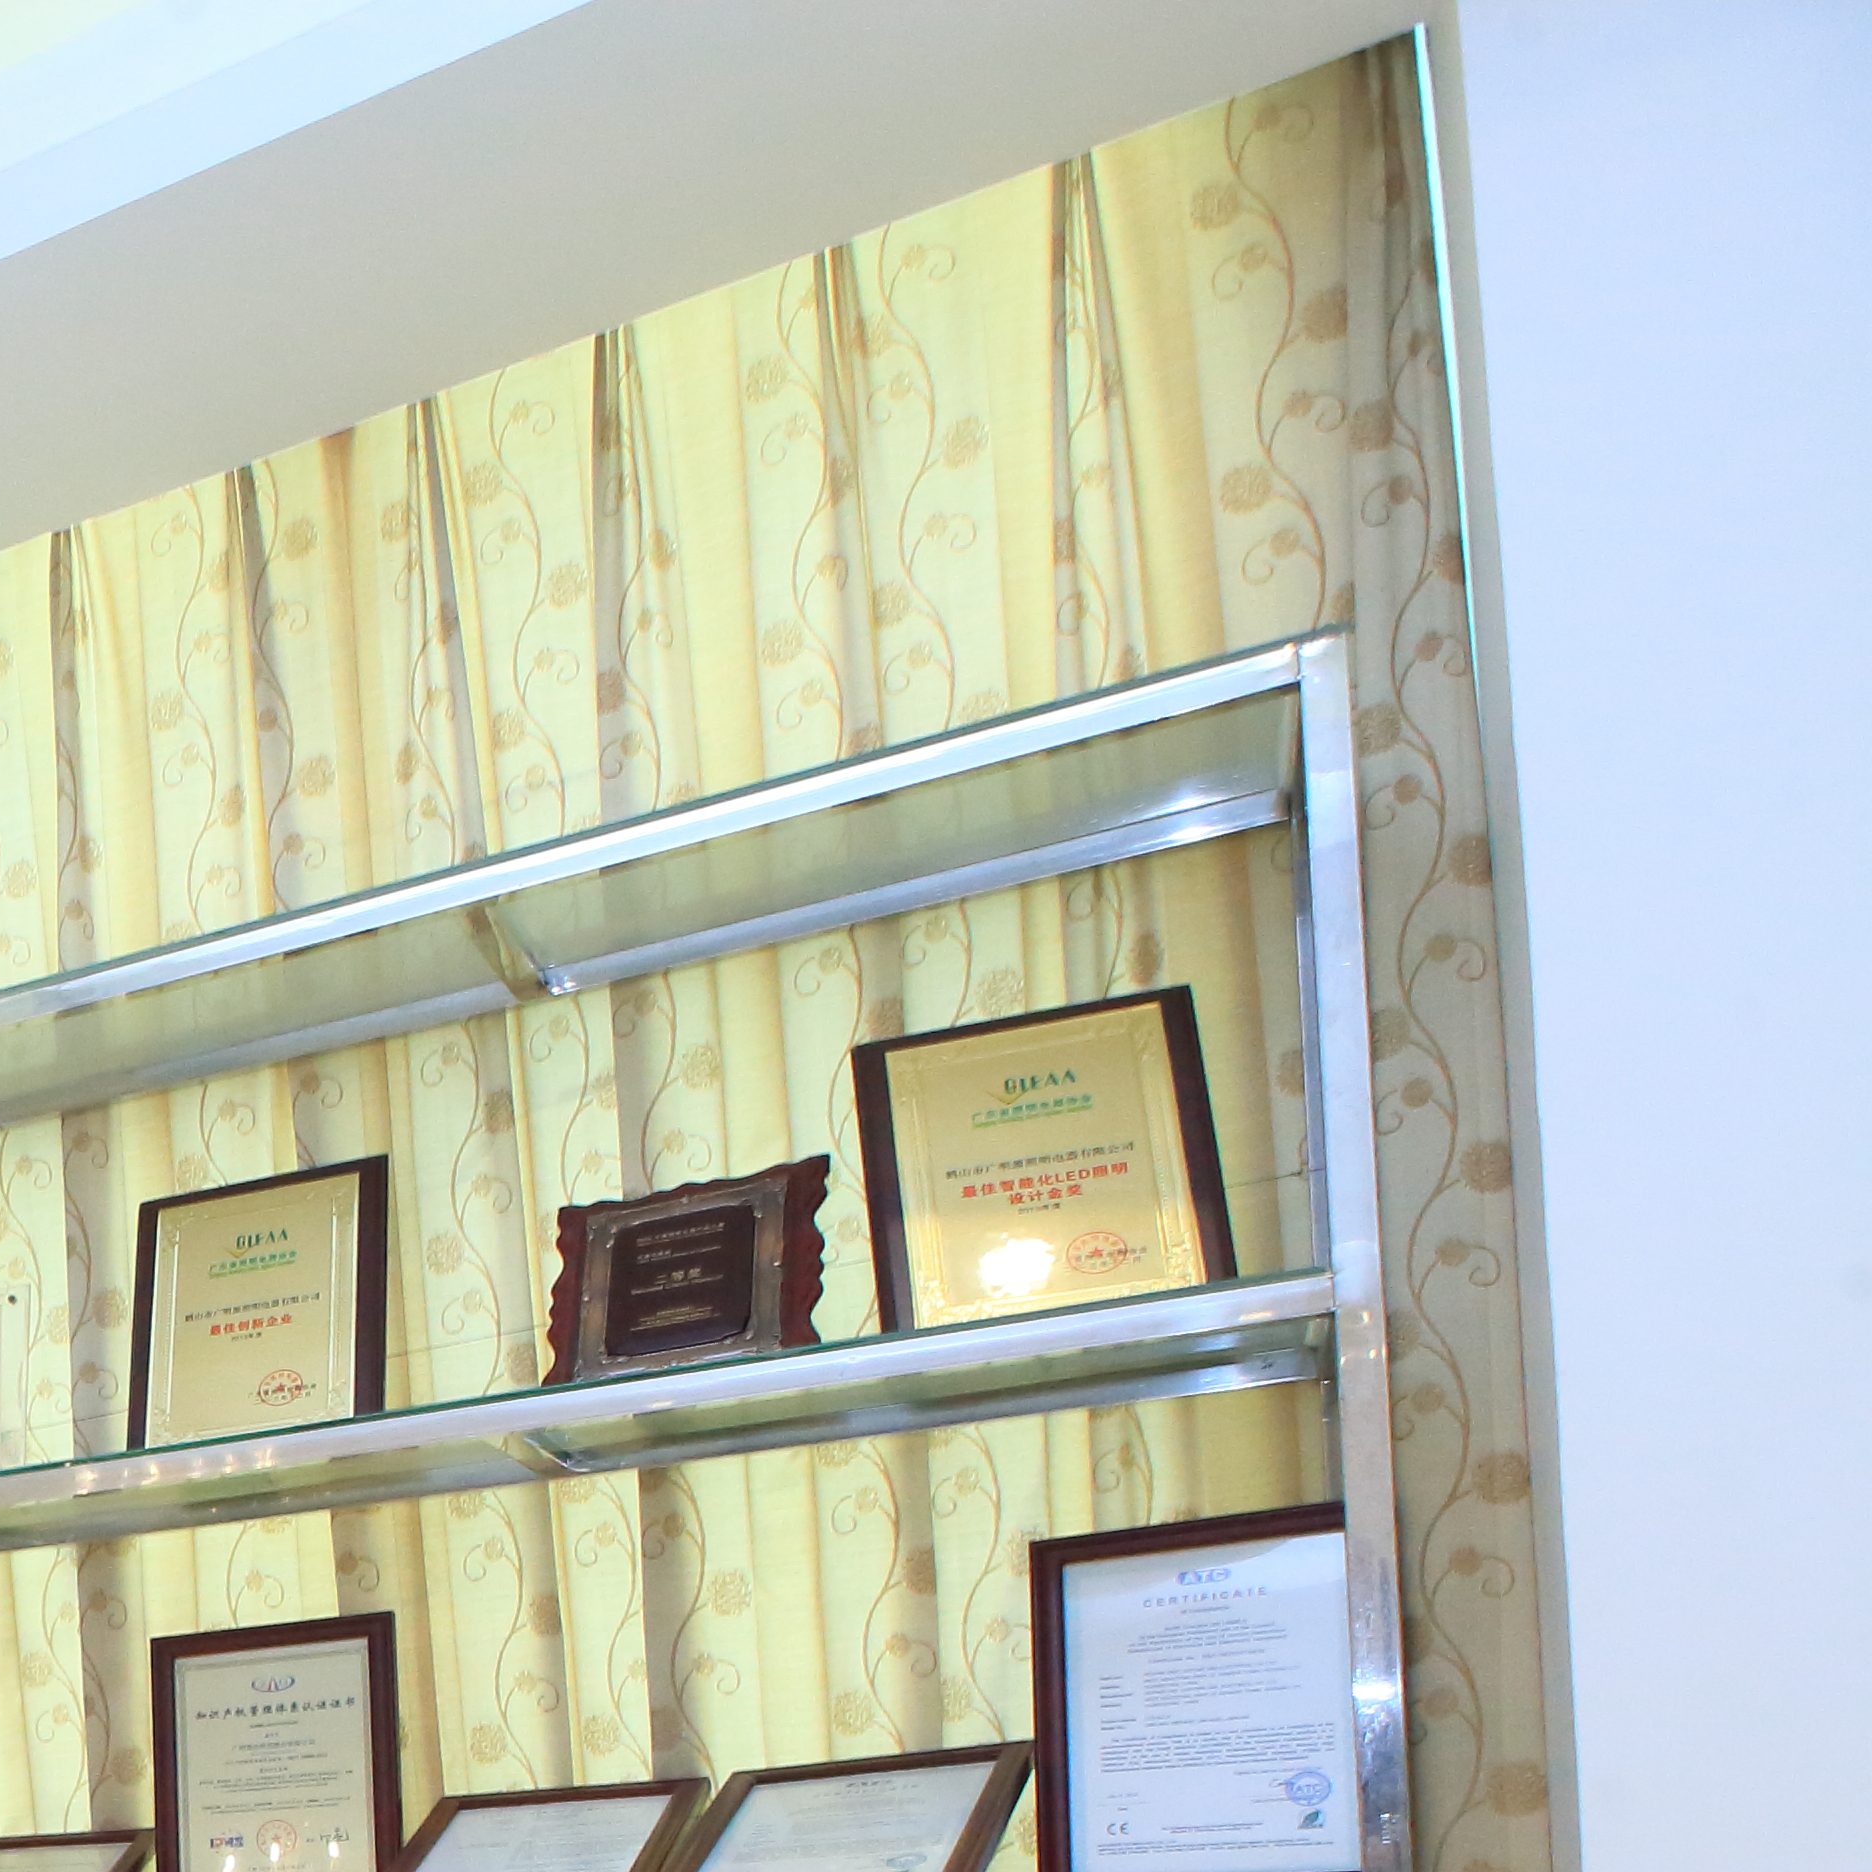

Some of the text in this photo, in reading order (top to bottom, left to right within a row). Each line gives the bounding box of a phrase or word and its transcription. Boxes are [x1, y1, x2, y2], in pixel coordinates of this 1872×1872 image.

[961, 1162, 1128, 1199] 最佳智能化LED照明
[1008, 1184, 1083, 1205] 设计金奖
[210, 1314, 293, 1337] 最佳创新企业
[1143, 1587, 1267, 1608] CERTIFICATE
[195, 1697, 356, 1721] 知识产权管理体系认证证书
